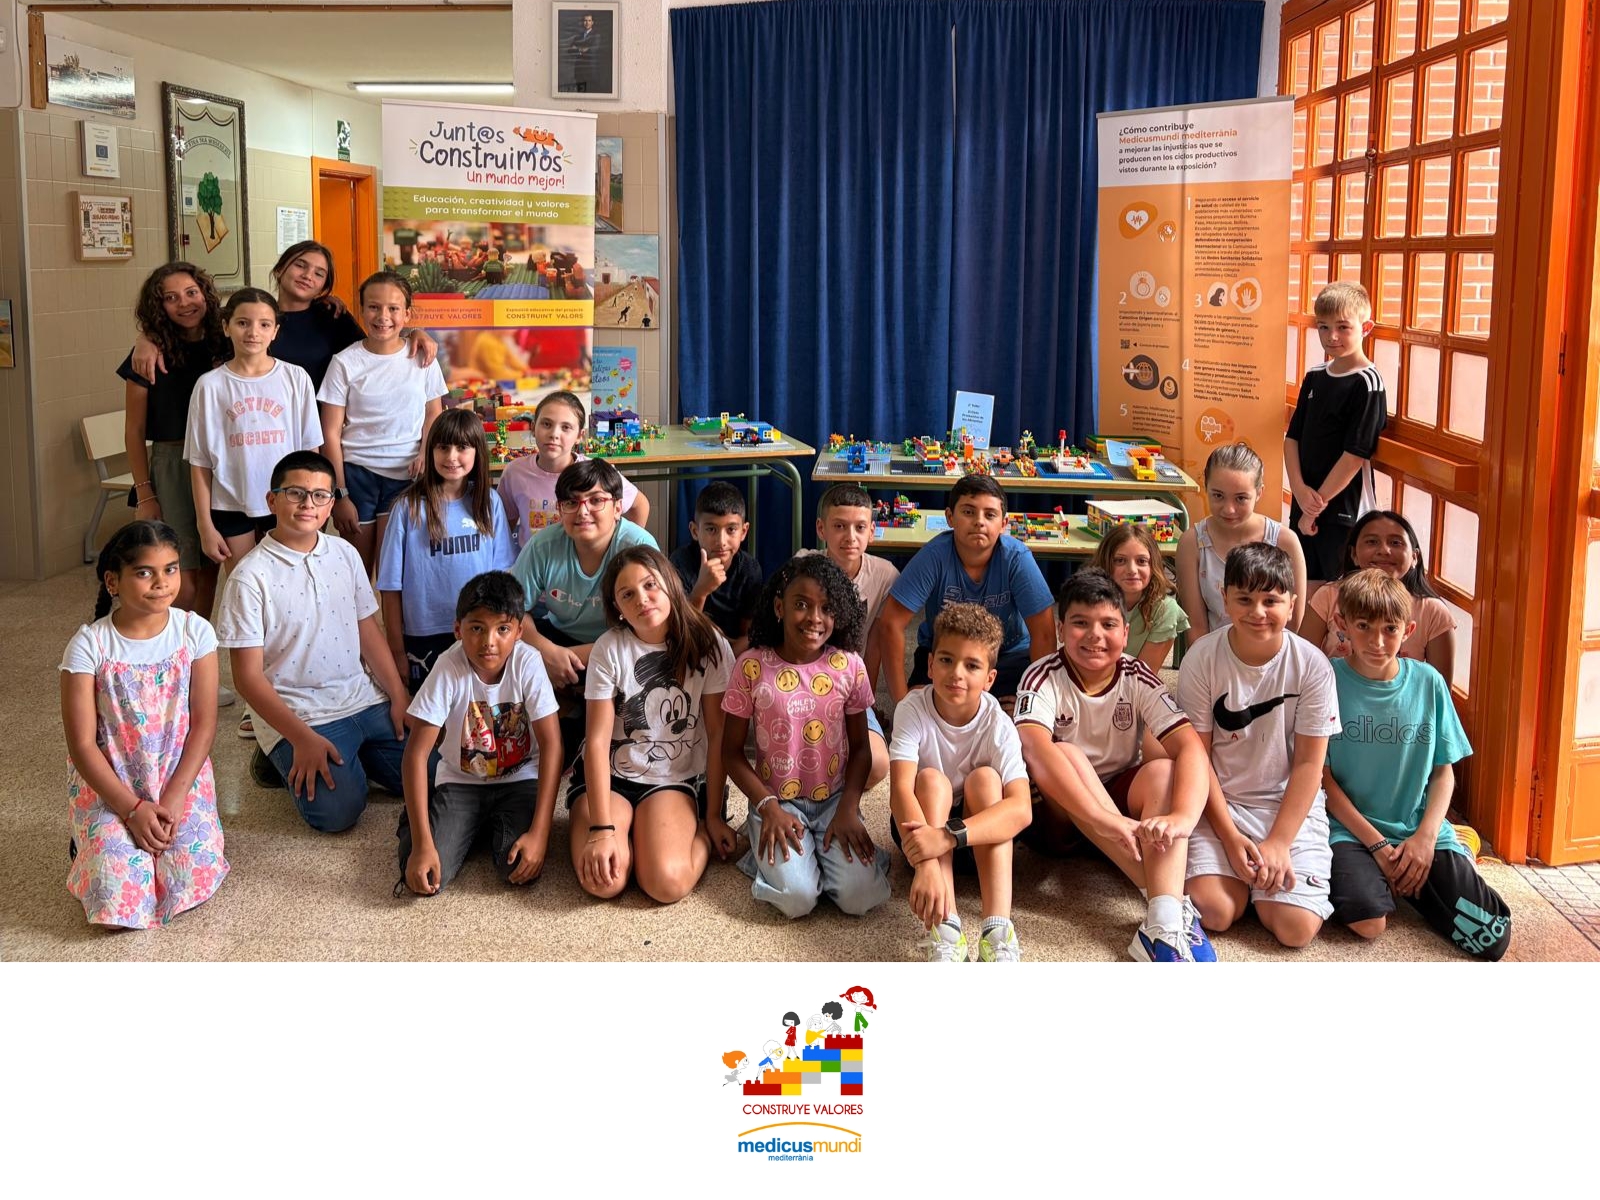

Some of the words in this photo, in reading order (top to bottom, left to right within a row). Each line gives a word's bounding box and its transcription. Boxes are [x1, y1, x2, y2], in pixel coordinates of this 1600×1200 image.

[429, 121, 505, 144] Junt@s
[1119, 125, 1147, 136] ¿Cómo
[1149, 122, 1194, 132] contribuye
[1119, 133, 1179, 144] Medicusmundi
[1182, 128, 1237, 140] mediterrània
[1125, 146, 1150, 154] mejorar
[1164, 142, 1197, 152] injusticias
[420, 140, 562, 172] Construimos
[1119, 154, 1151, 165] producen
[1195, 150, 1237, 160] productivos
[1176, 162, 1217, 172] exposición?
[467, 171, 482, 184] Un
[486, 172, 524, 186] mundo
[528, 175, 565, 191] mejor!
[413, 194, 467, 206] Educación,
[469, 196, 524, 207] creatividad
[526, 200, 532, 208] y
[536, 199, 569, 209] valores
[425, 207, 449, 216] para
[452, 206, 512, 218] transformar
[515, 209, 523, 217] el
[526, 209, 558, 219] mundo
[1119, 292, 1127, 305] 2
[1194, 294, 1202, 308] 3
[1182, 358, 1190, 371] 4
[226, 396, 284, 422] ACTIVE
[1120, 404, 1128, 416] 5
[229, 429, 286, 448] SOCIETY
[430, 534, 480, 558] PUMA
